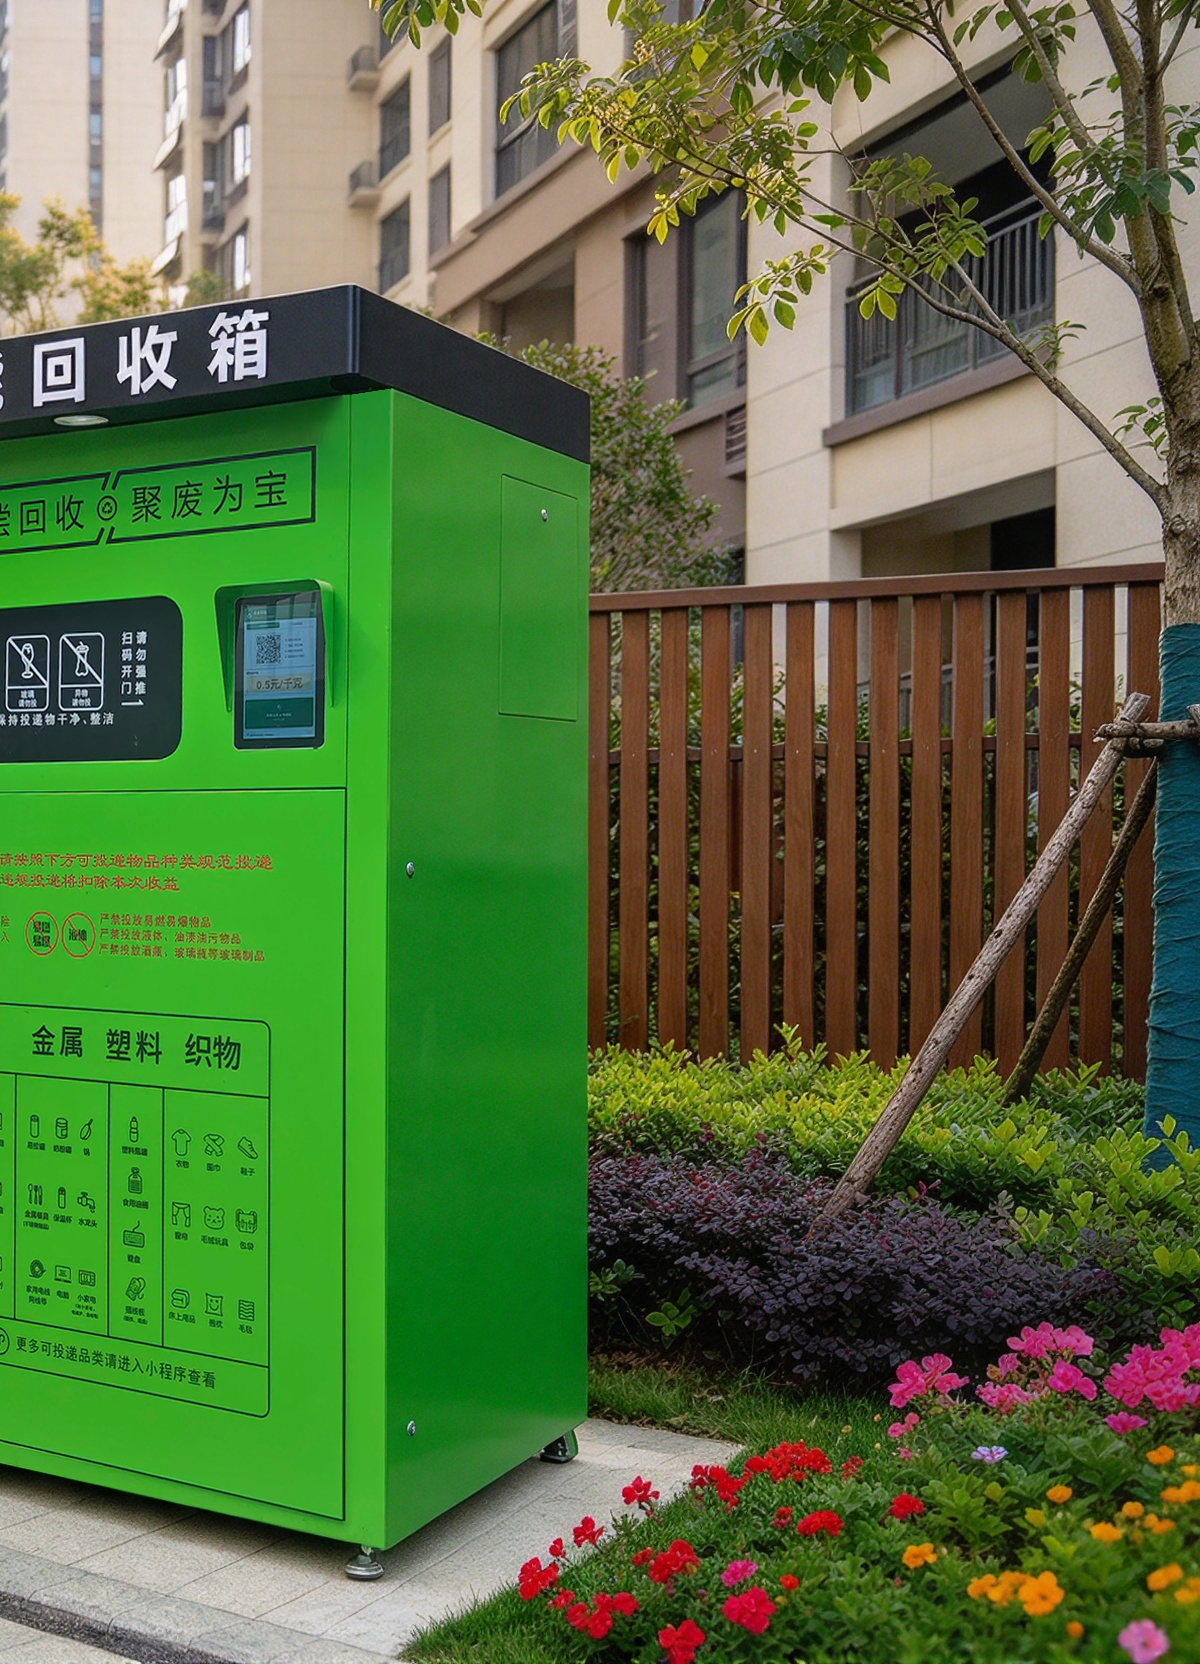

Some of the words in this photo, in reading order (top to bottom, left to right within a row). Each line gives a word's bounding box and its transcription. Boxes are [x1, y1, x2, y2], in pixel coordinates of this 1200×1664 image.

[131, 469, 289, 522] 聚废为宝
[122, 632, 132, 694] 扫码开门
[135, 631, 147, 695] 请勿强推
[256, 677, 303, 690] 0.5元/千克
[0, 873, 179, 892] 违规投递将扣除本次收益
[100, 913, 211, 928] 严禁投放易燃易爆物品
[32, 1025, 82, 1058] 金属
[106, 1029, 162, 1064] 塑料
[185, 1033, 241, 1070] 织物
[15, 1335, 217, 1389] 更多可投递品类请进入小程序查看
